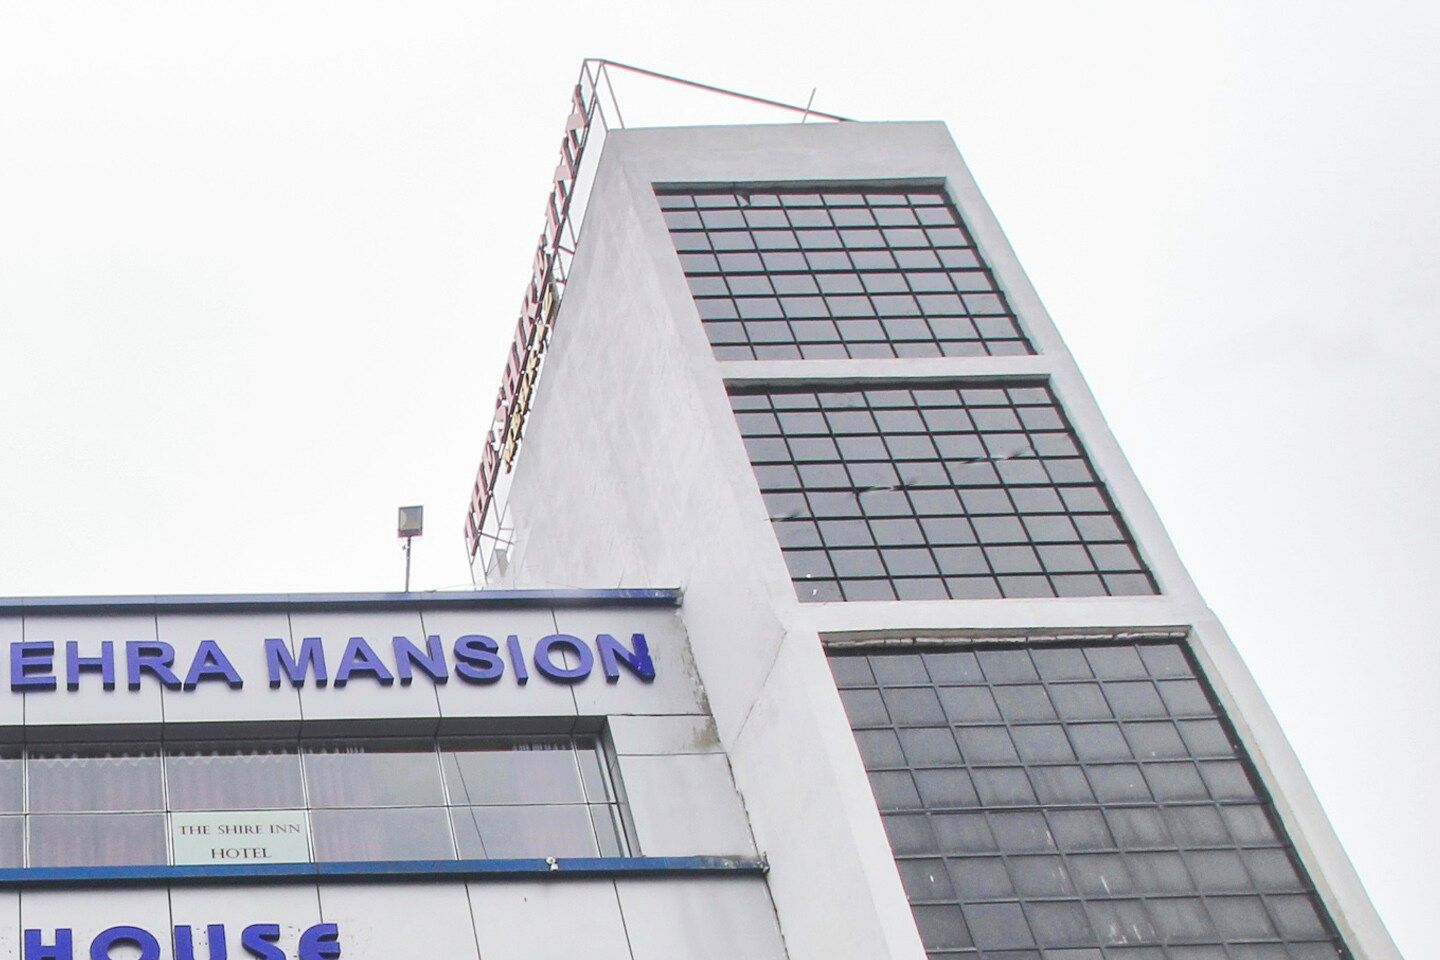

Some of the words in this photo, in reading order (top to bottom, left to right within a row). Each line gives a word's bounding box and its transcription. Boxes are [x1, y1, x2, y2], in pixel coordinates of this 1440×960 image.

[264, 633, 656, 687] MANSION
[180, 825, 210, 835] THE
[218, 824, 262, 835] SHIRE
[270, 824, 301, 834] INN
[211, 848, 272, 859] HOTEL
